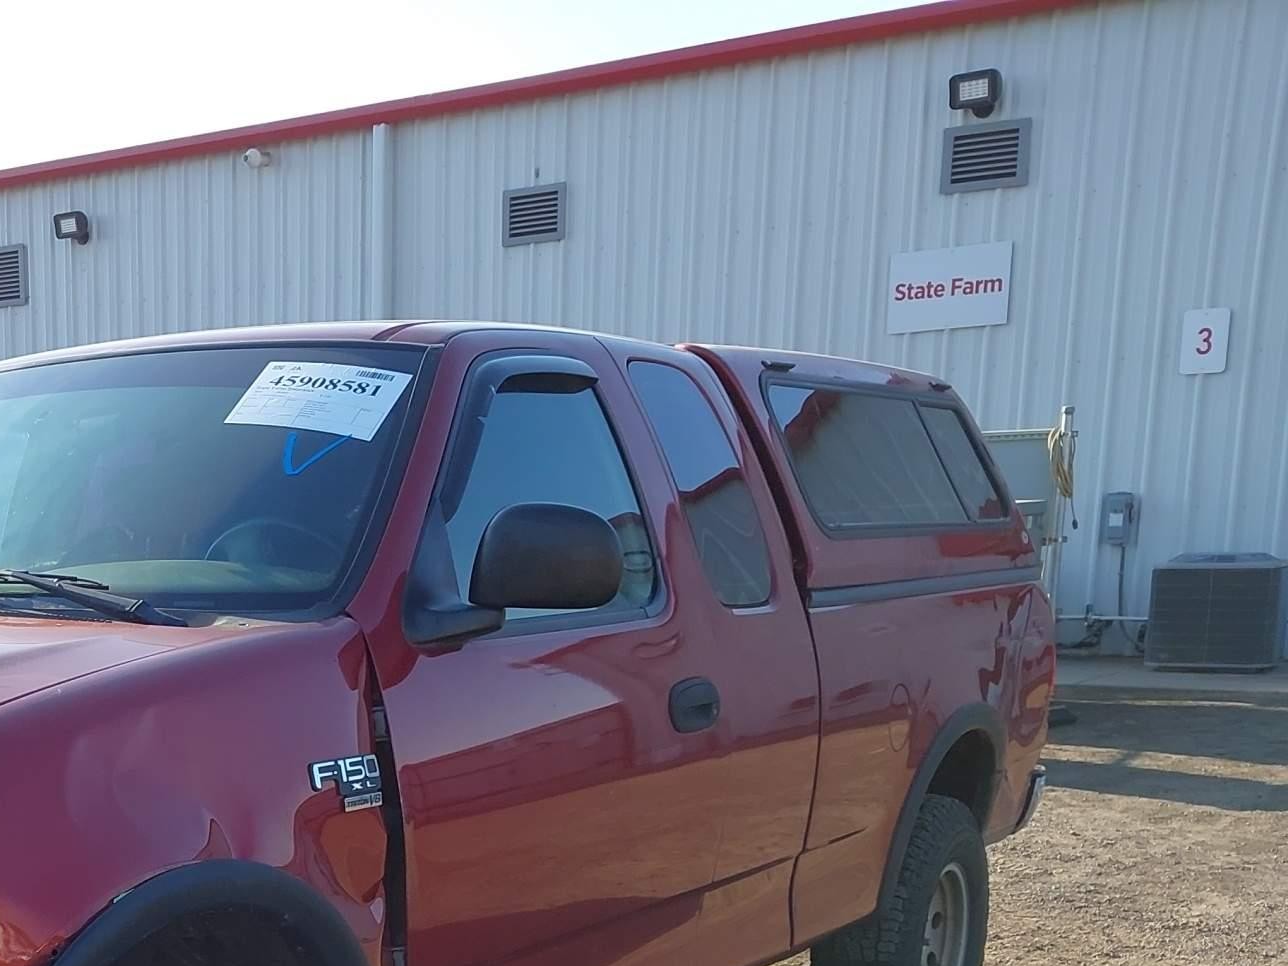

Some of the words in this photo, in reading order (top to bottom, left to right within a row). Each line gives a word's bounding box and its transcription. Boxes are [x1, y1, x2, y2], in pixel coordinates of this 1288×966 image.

[894, 281, 945, 301] State
[950, 277, 1003, 298] Farm
[1195, 327, 1213, 355] 3
[270, 375, 382, 397] 45908581
[313, 754, 380, 789] F-150
[351, 780, 377, 791] XL
[369, 794, 381, 806] V8
